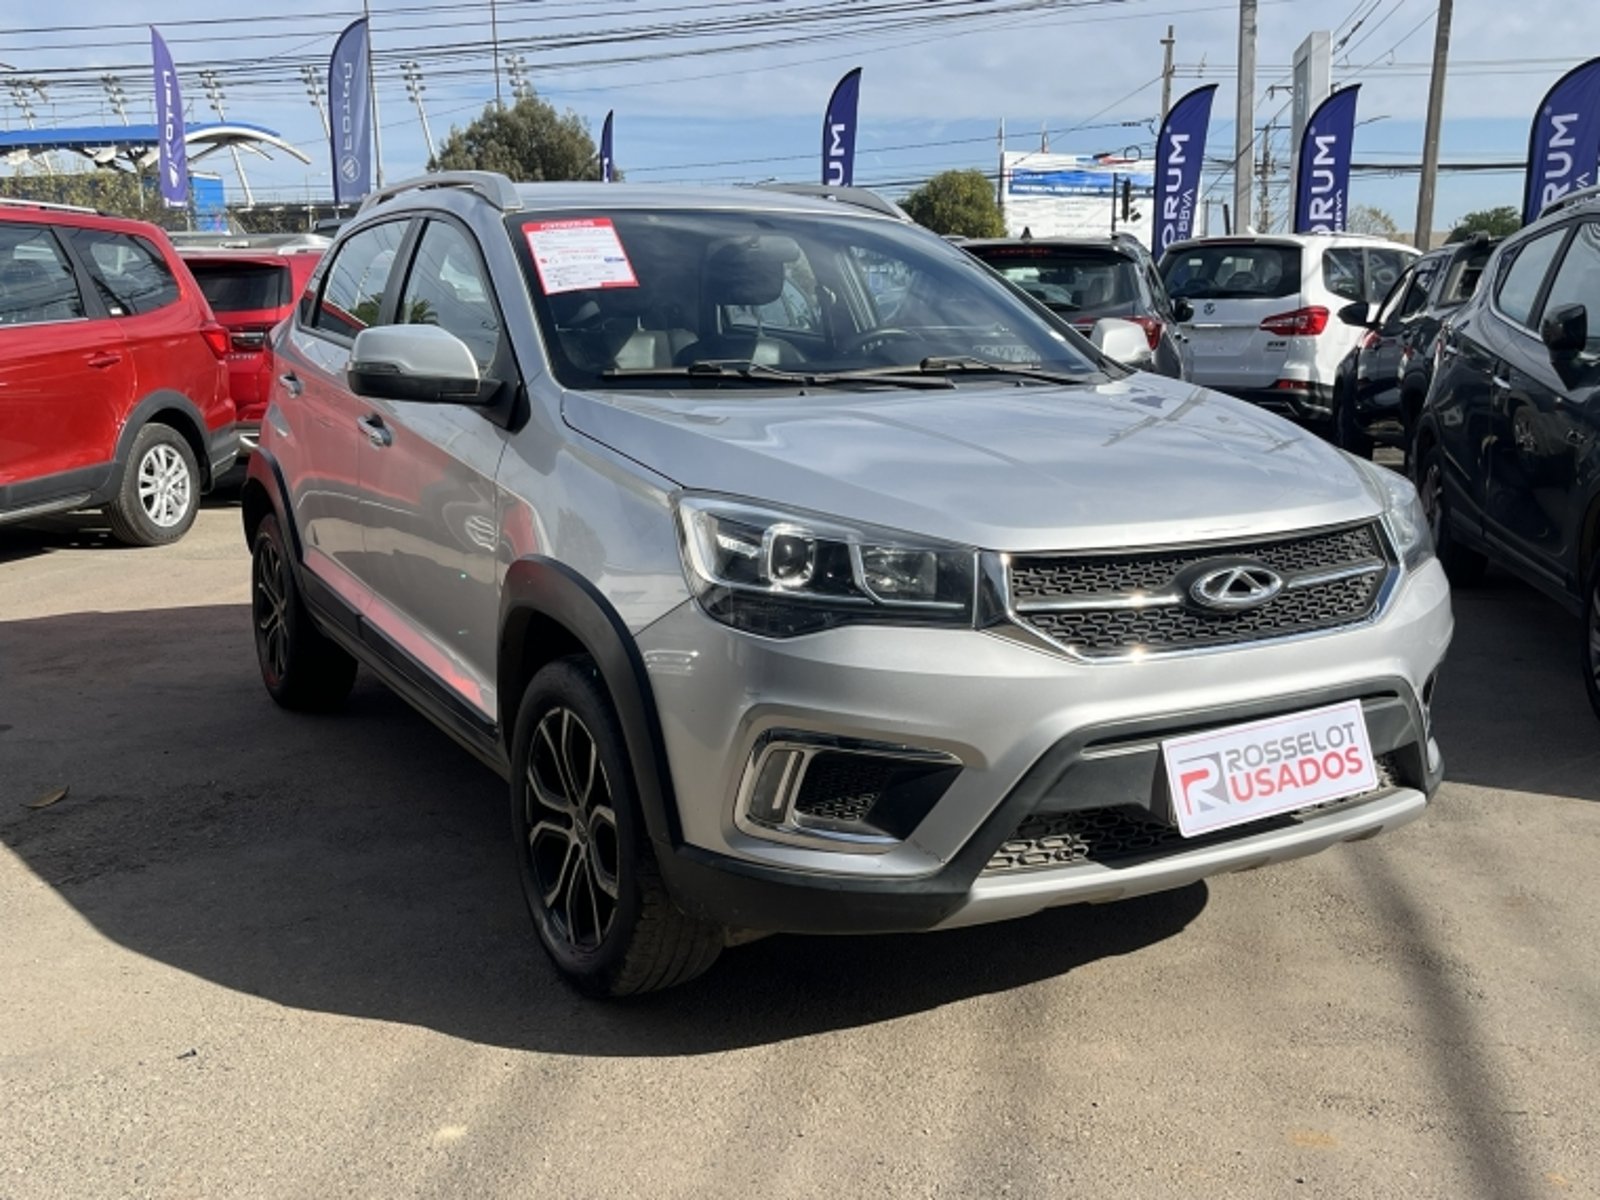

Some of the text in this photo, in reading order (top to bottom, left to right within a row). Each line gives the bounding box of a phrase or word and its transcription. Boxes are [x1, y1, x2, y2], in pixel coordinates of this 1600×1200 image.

[829, 123, 845, 186] UM
[1541, 113, 1579, 208] RUM
[1162, 134, 1190, 249] ORUM
[1225, 722, 1355, 773] ROSSELOT
[1230, 746, 1364, 802] USADOS
